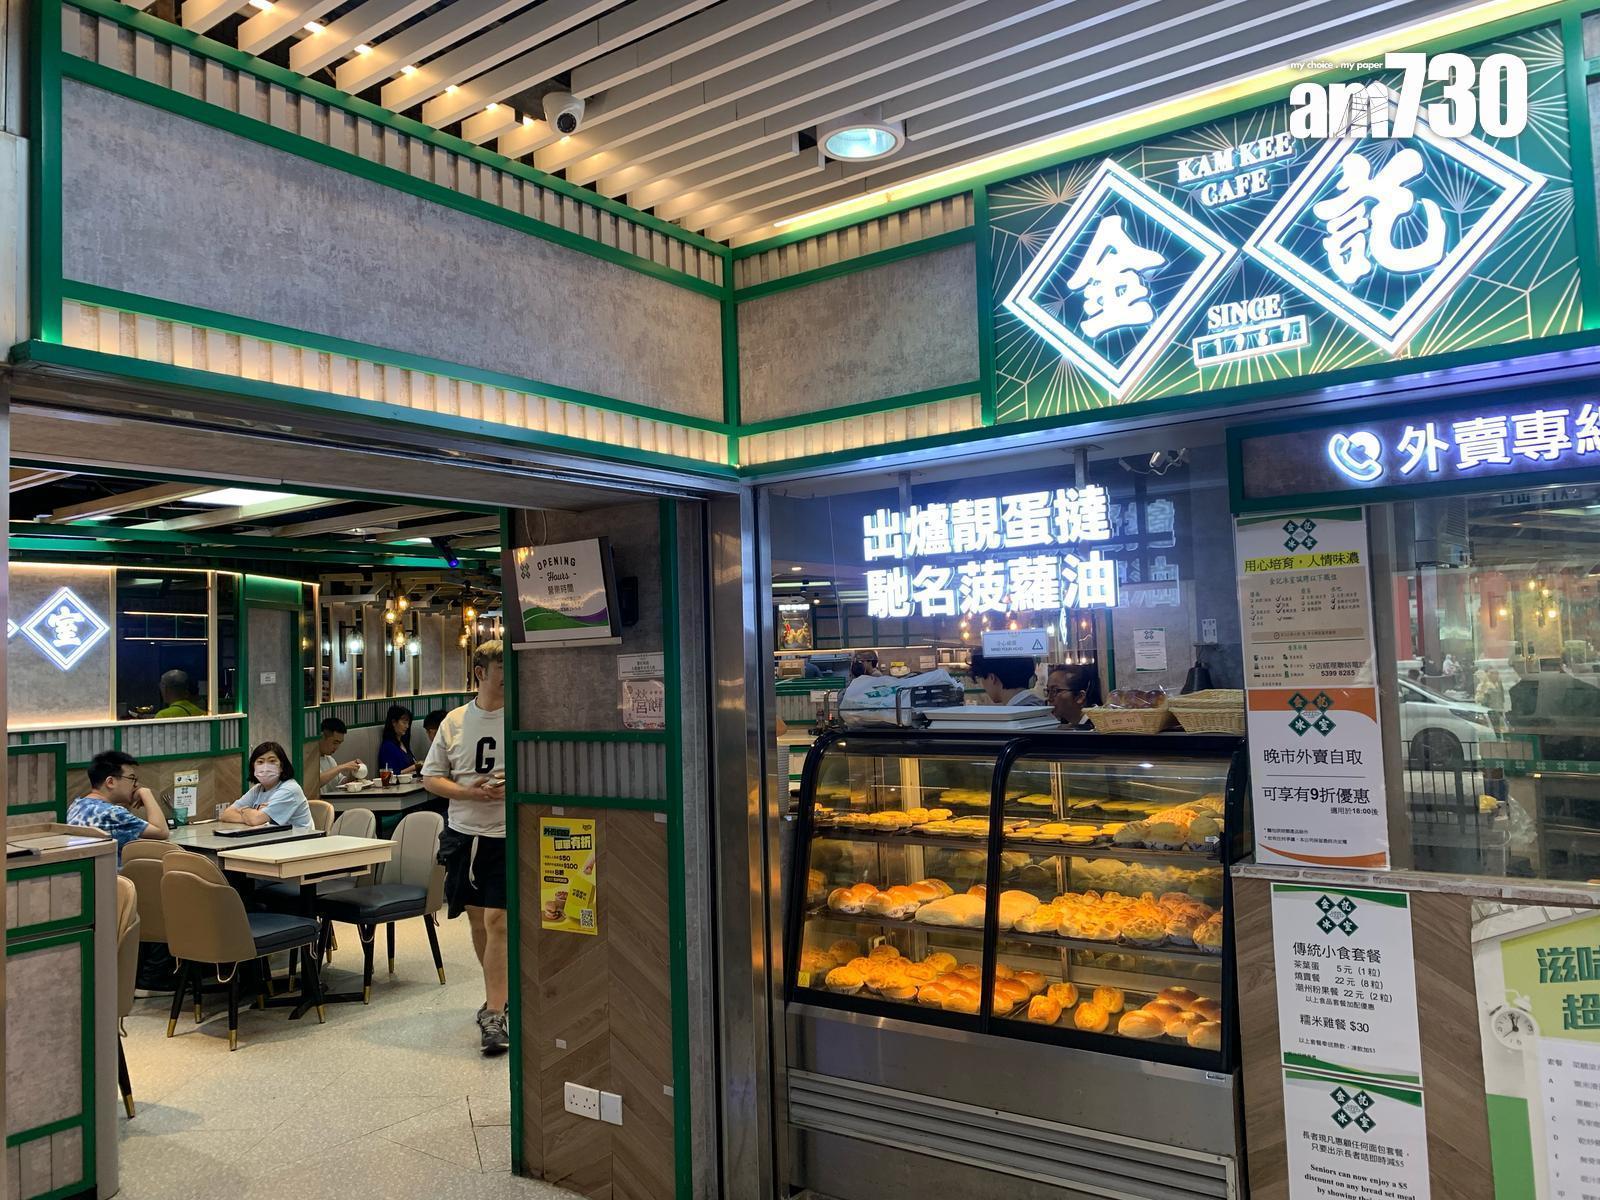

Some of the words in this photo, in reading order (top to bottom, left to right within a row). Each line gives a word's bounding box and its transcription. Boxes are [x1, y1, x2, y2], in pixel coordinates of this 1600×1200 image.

[1177, 147, 1234, 183] KAM
[1239, 132, 1294, 167] KEE
[1200, 168, 1268, 207] CAFE
[1207, 293, 1281, 330] SINCE
[863, 484, 1113, 562] 出爐靚蛋撻
[537, 556, 576, 571] OPENING
[547, 571, 570, 582] Hours
[866, 549, 1118, 619] 馳名菠蘿油
[47, 605, 85, 648] 室
[475, 737, 496, 774] G
[1264, 749, 1363, 765] 晚市外賣自取
[1262, 786, 1370, 804] 可享有9折優惠
[1293, 942, 1381, 964] 傳統小食套餐
[1294, 960, 1320, 971] 茶葉蛋
[1296, 983, 1338, 996] 潮州粉果餐
[1300, 1014, 1346, 1031] 糯米雞餐
[1350, 1022, 1370, 1033] $30
[1304, 1173, 1334, 1186] discount
[1346, 1184, 1359, 1192] any
[1362, 1186, 1382, 1196] bread
[1310, 1164, 1336, 1176] Seniors
[1370, 1178, 1390, 1188] enjoy
[1318, 1186, 1326, 1195] by
[1328, 1188, 1356, 1200] showing
